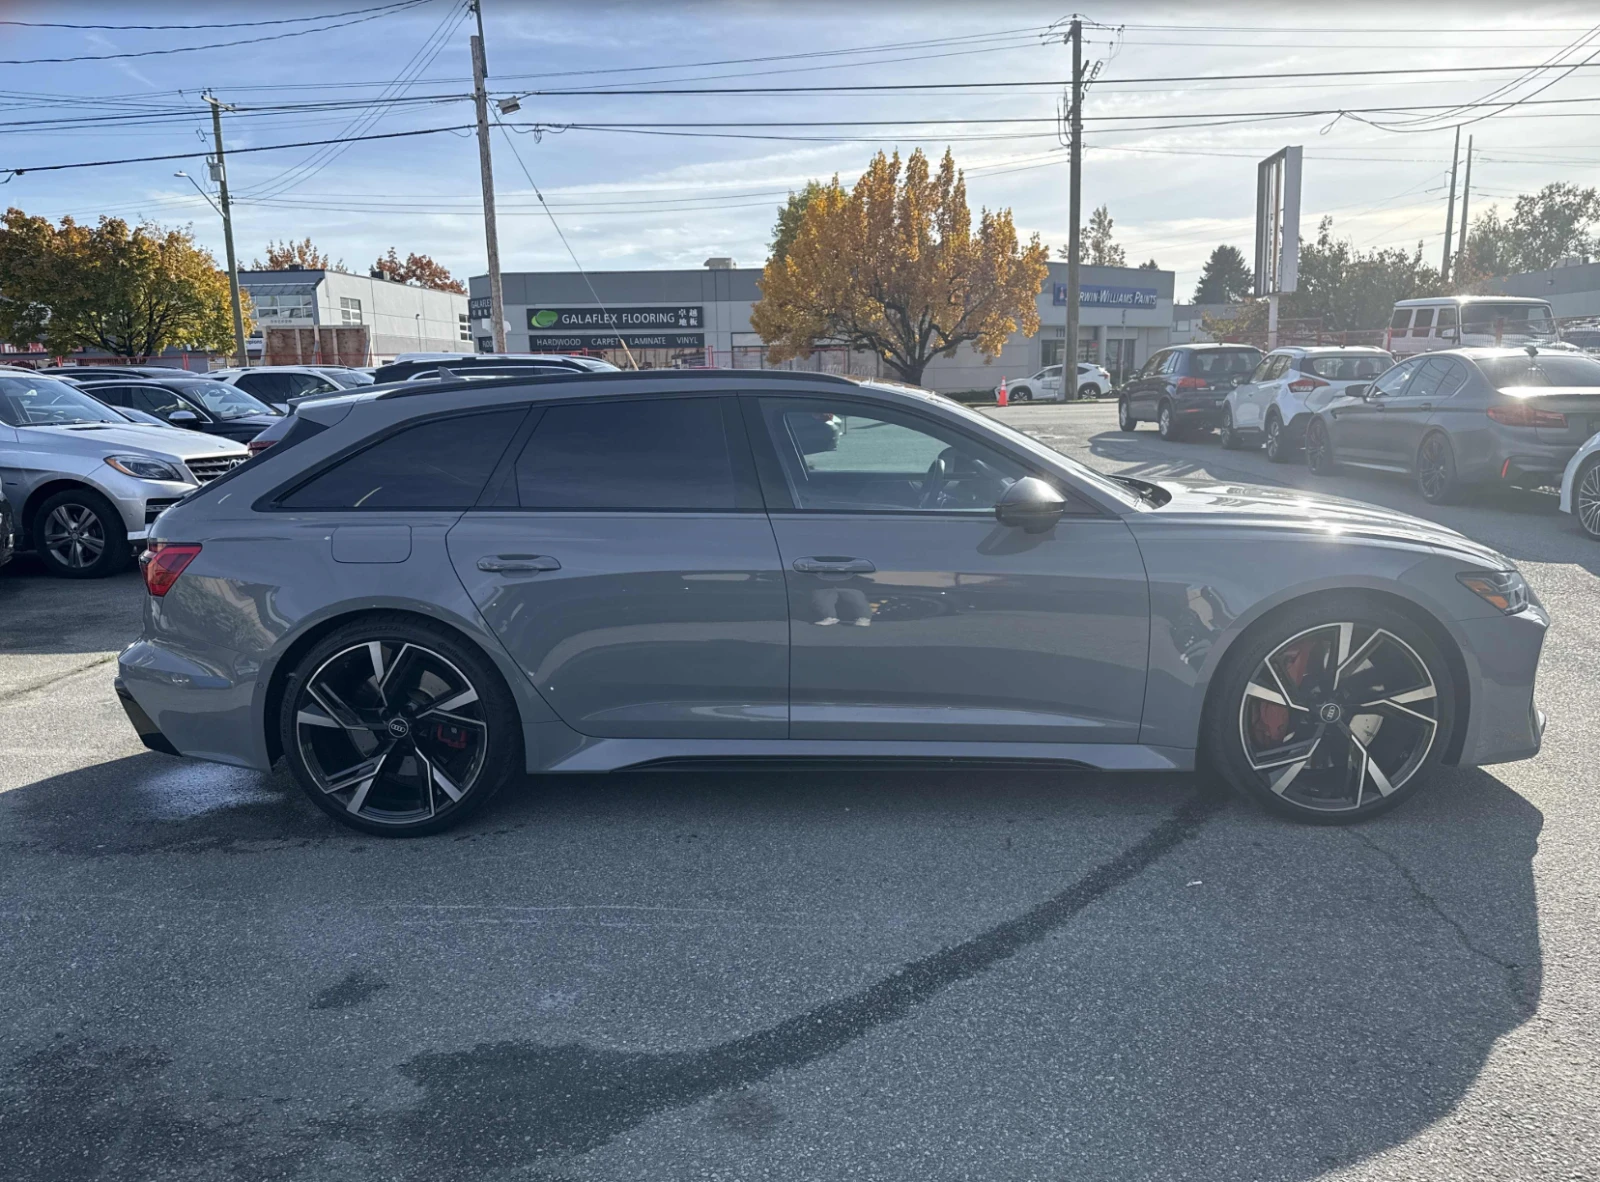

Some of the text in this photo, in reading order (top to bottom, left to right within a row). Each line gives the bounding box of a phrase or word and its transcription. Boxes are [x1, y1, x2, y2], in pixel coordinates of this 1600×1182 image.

[1078, 289, 1133, 304] RWIN-WILLIAMS
[561, 313, 675, 324] GALAFLEX FLOORING
[536, 336, 699, 346] HARDWOOD CARPET LAMINATE VINYL
